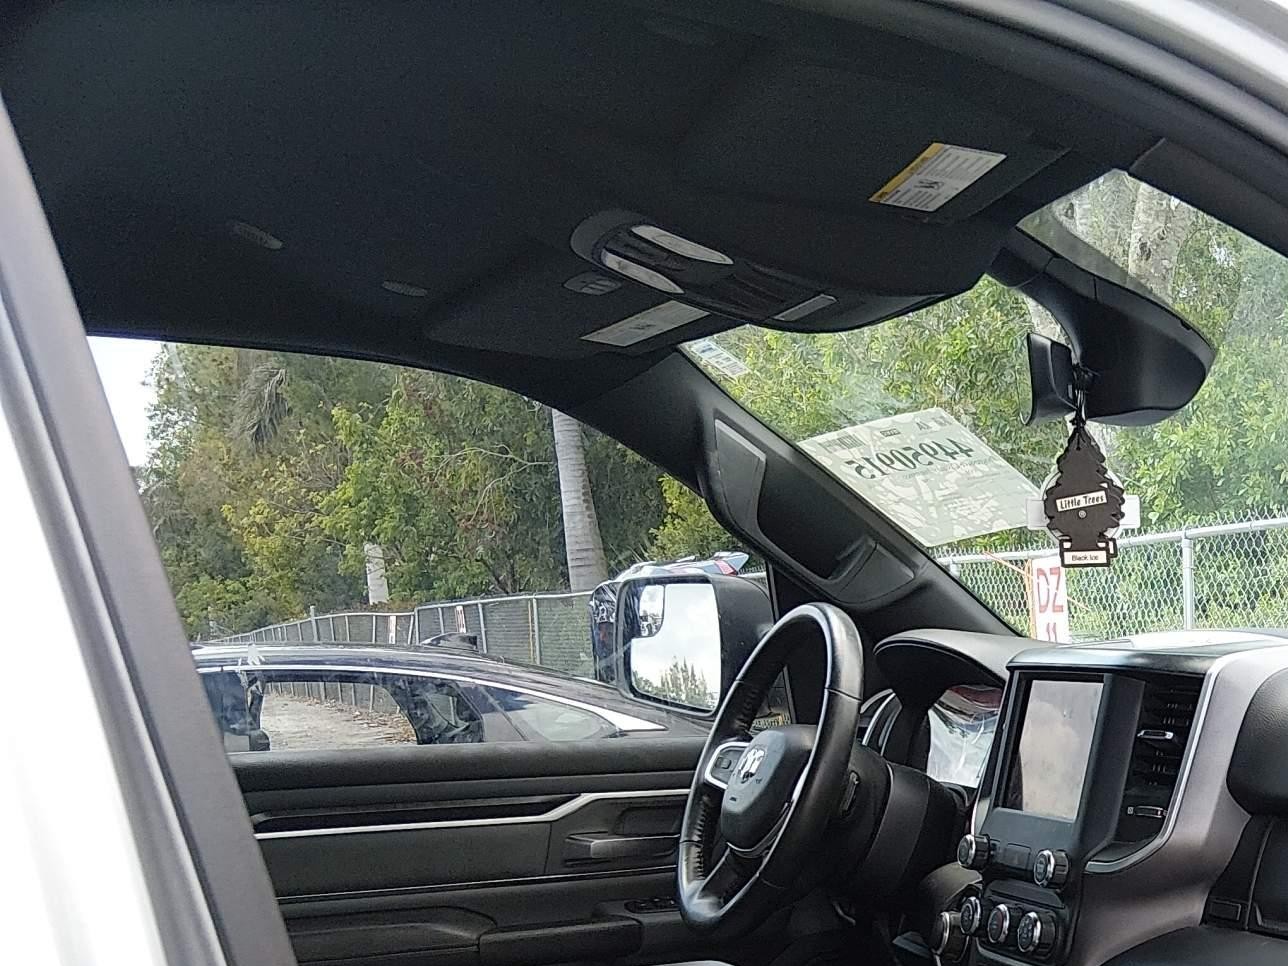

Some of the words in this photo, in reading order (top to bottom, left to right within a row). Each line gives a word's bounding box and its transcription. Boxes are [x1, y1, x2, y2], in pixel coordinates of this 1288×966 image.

[1060, 498, 1081, 510] Little
[1082, 494, 1104, 505] Trees
[1071, 554, 1089, 562] Black
[1037, 566, 1063, 613] DZ
